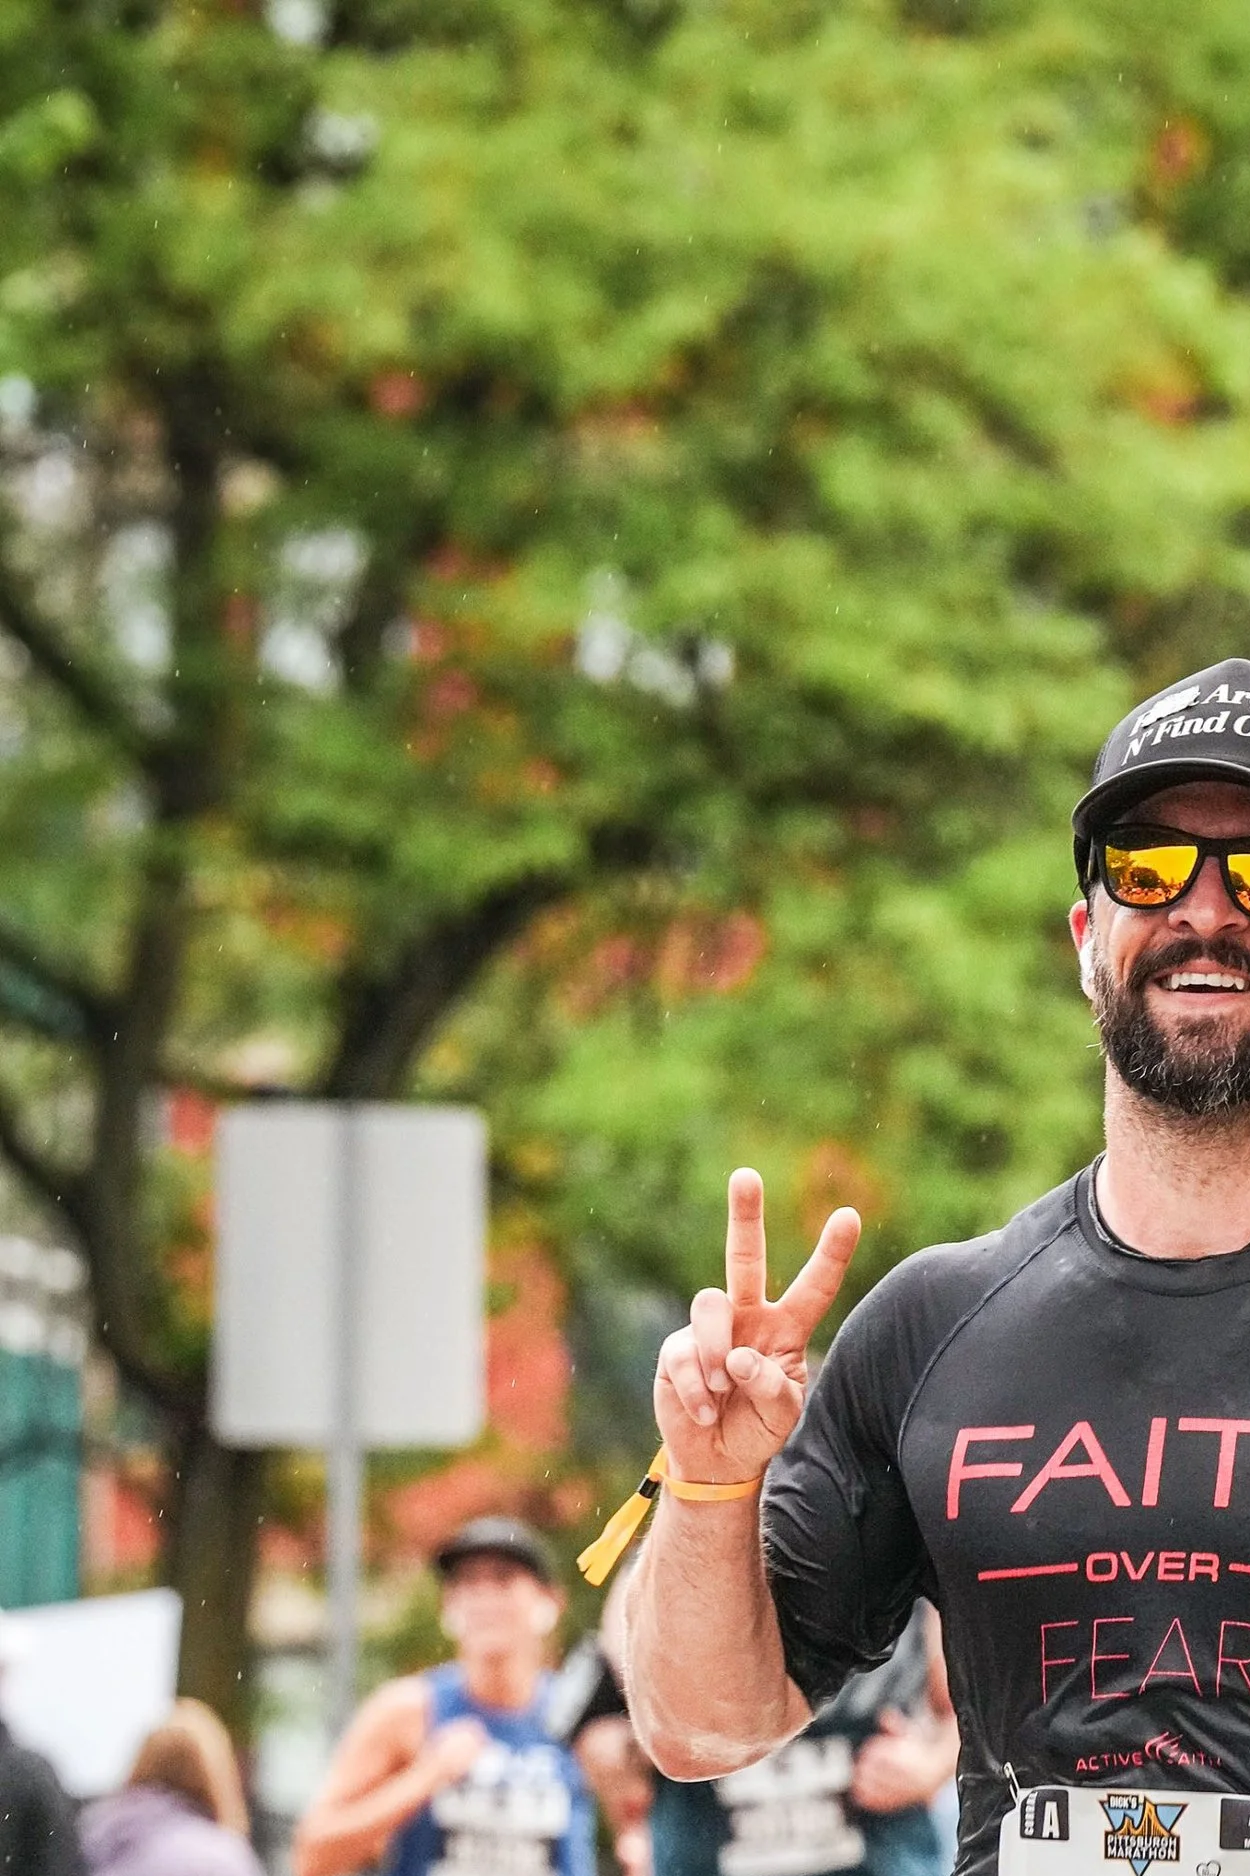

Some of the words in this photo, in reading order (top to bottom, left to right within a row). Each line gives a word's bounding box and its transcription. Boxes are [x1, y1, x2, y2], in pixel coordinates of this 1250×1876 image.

[1151, 710, 1231, 746] Find
[1085, 1552, 1220, 1582] OVER
[1076, 1752, 1143, 1772] ACTIVE
[1042, 1801, 1060, 1838] A
[1107, 1834, 1177, 1850] PITTSBURGH
[1107, 1845, 1177, 1860] MARATHON
